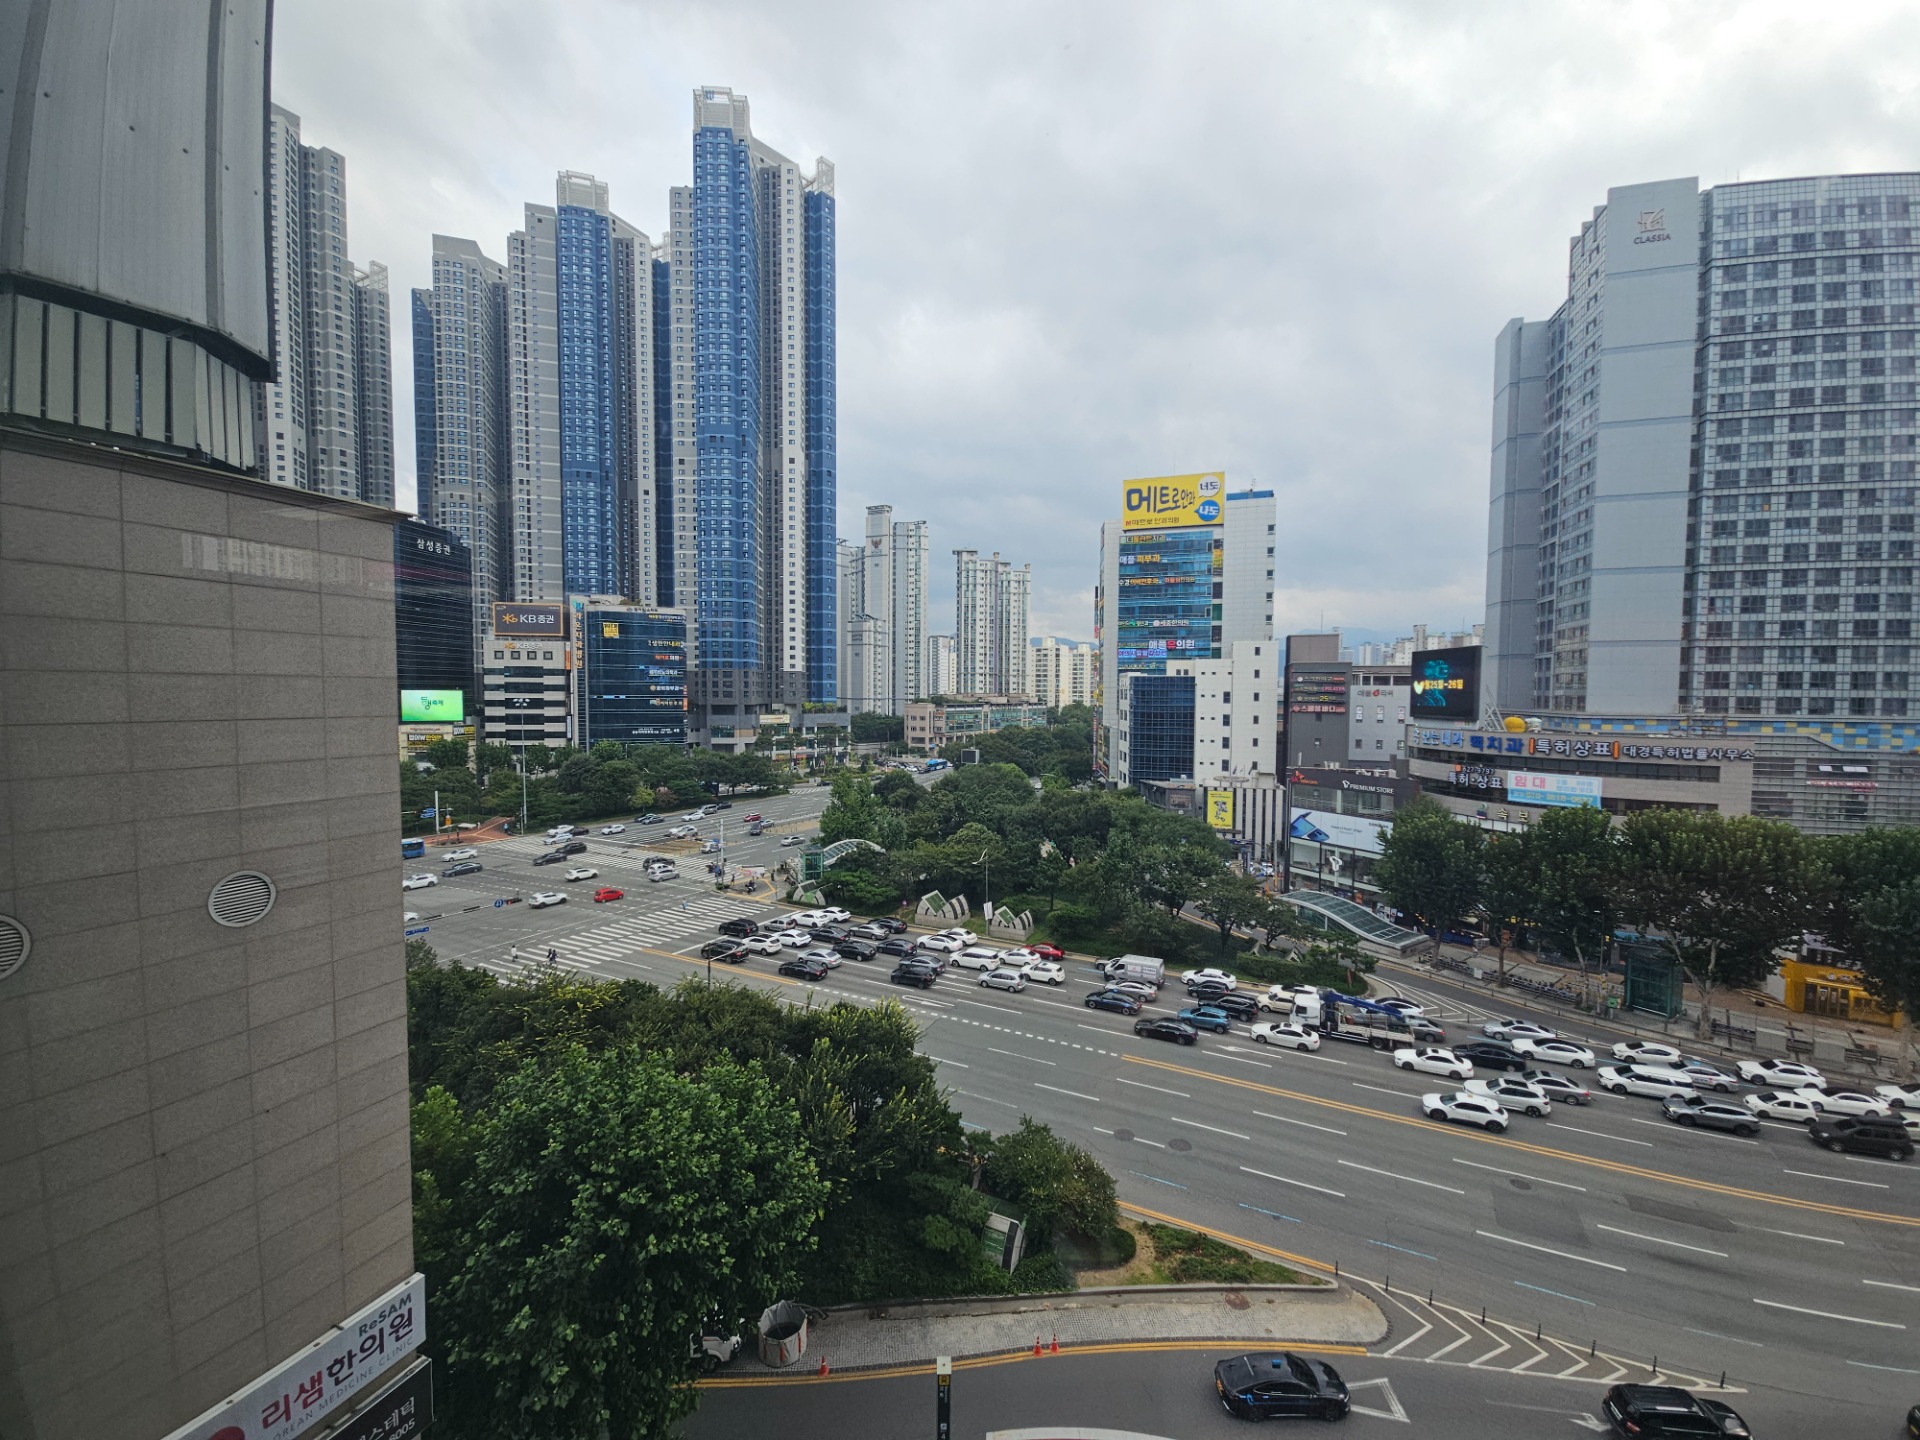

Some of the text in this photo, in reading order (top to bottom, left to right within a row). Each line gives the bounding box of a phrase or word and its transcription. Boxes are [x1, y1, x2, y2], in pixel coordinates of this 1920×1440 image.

[1633, 233, 1671, 245] CLASSIA
[1200, 481, 1219, 491] 너도
[1199, 505, 1219, 515] 나도
[416, 538, 451, 555] 삼성증권
[520, 614, 554, 624] KB증권
[1535, 739, 1755, 760] 특허상표 대경특허법률사무소
[1350, 783, 1394, 794] PREMIUM STORE
[358, 1293, 412, 1338] ReSAM
[261, 1307, 414, 1430] 리샘한의원
[272, 1335, 414, 1440] OREAN MEDICINE CLINIC
